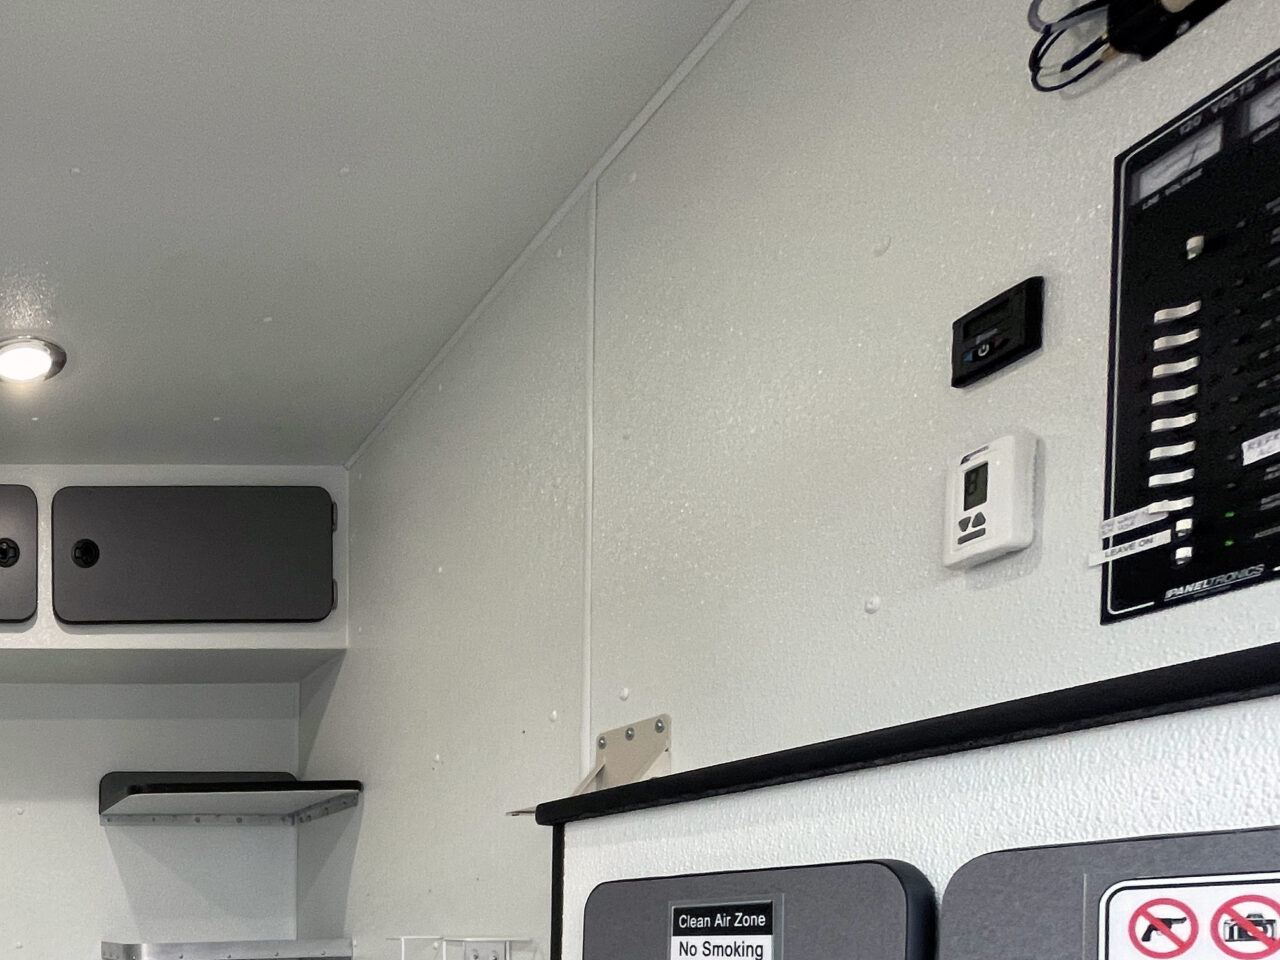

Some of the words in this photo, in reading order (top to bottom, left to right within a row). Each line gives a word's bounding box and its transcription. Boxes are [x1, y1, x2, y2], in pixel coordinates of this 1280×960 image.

[1105, 541, 1136, 558] LEAVE
[1138, 537, 1153, 547] ON
[1165, 564, 1266, 599] PANELTRONICS
[678, 914, 711, 928] Clean
[714, 913, 731, 927] Air
[734, 912, 766, 927] Zone
[679, 941, 698, 957] No
